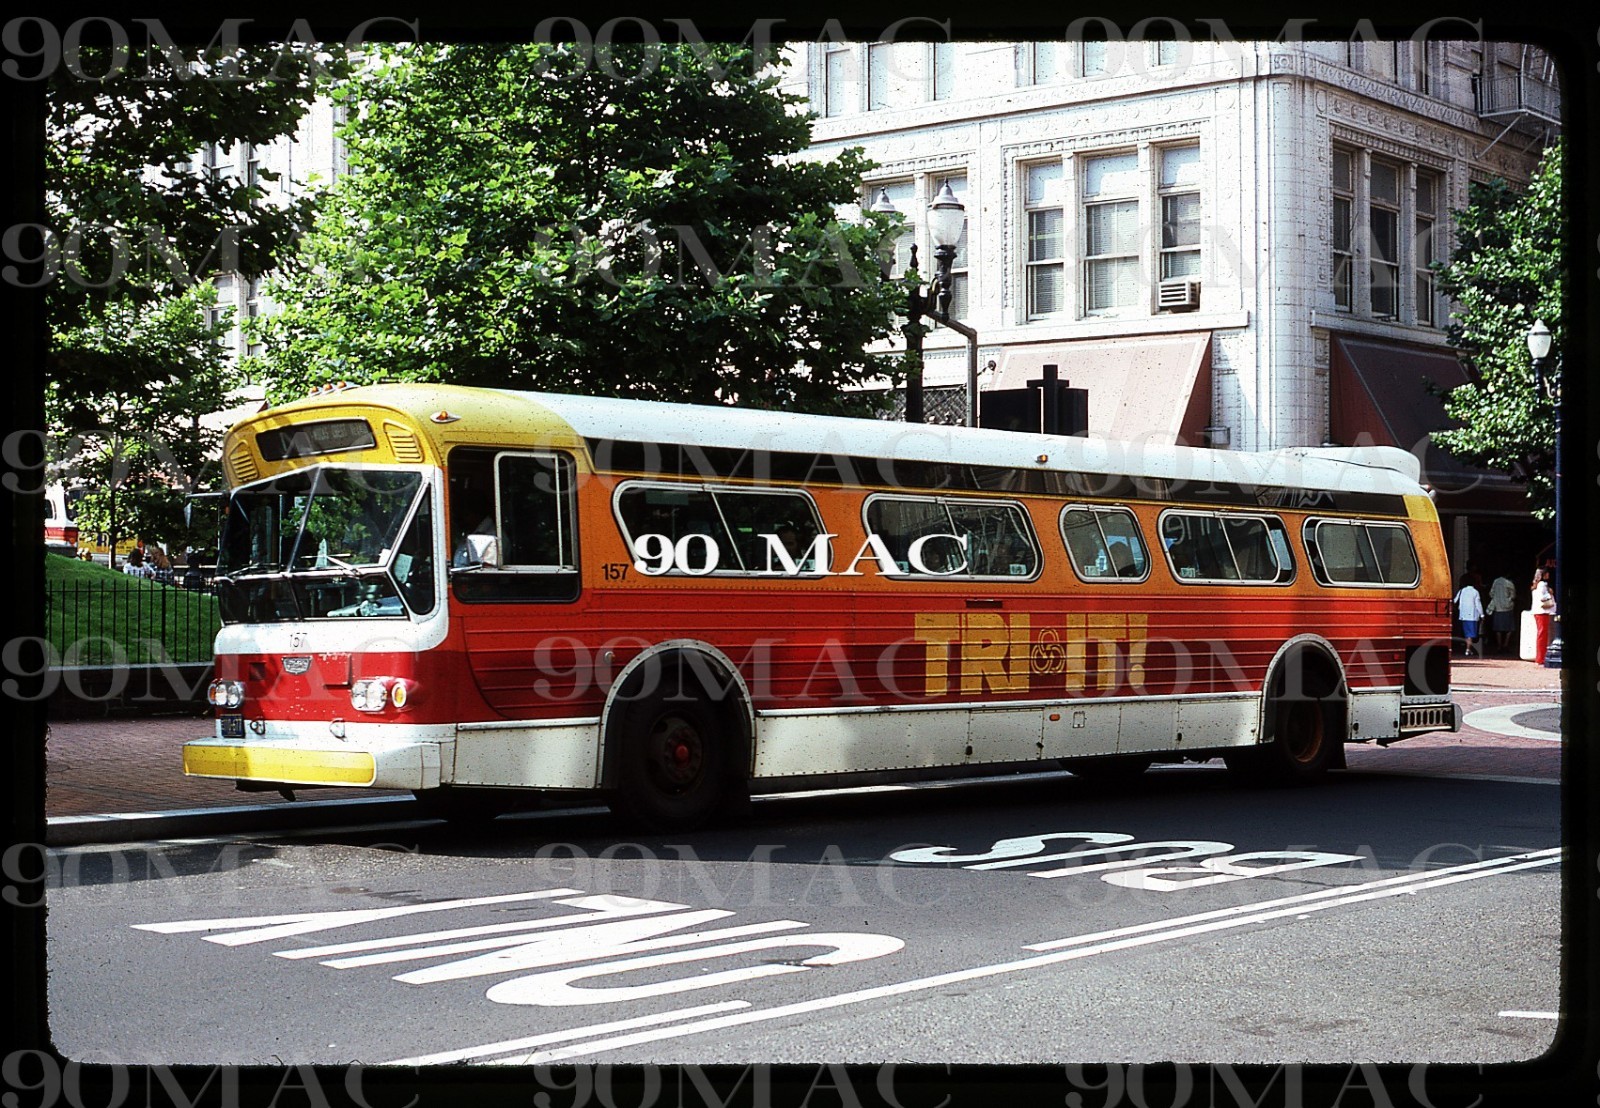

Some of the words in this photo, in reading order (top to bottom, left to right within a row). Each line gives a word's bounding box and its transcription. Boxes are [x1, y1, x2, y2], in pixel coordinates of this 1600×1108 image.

[602, 564, 629, 581] 157
[289, 632, 308, 648] 157
[914, 613, 1031, 696] TRI
[889, 831, 1367, 892] BUS
[131, 887, 906, 1007] ONLY
